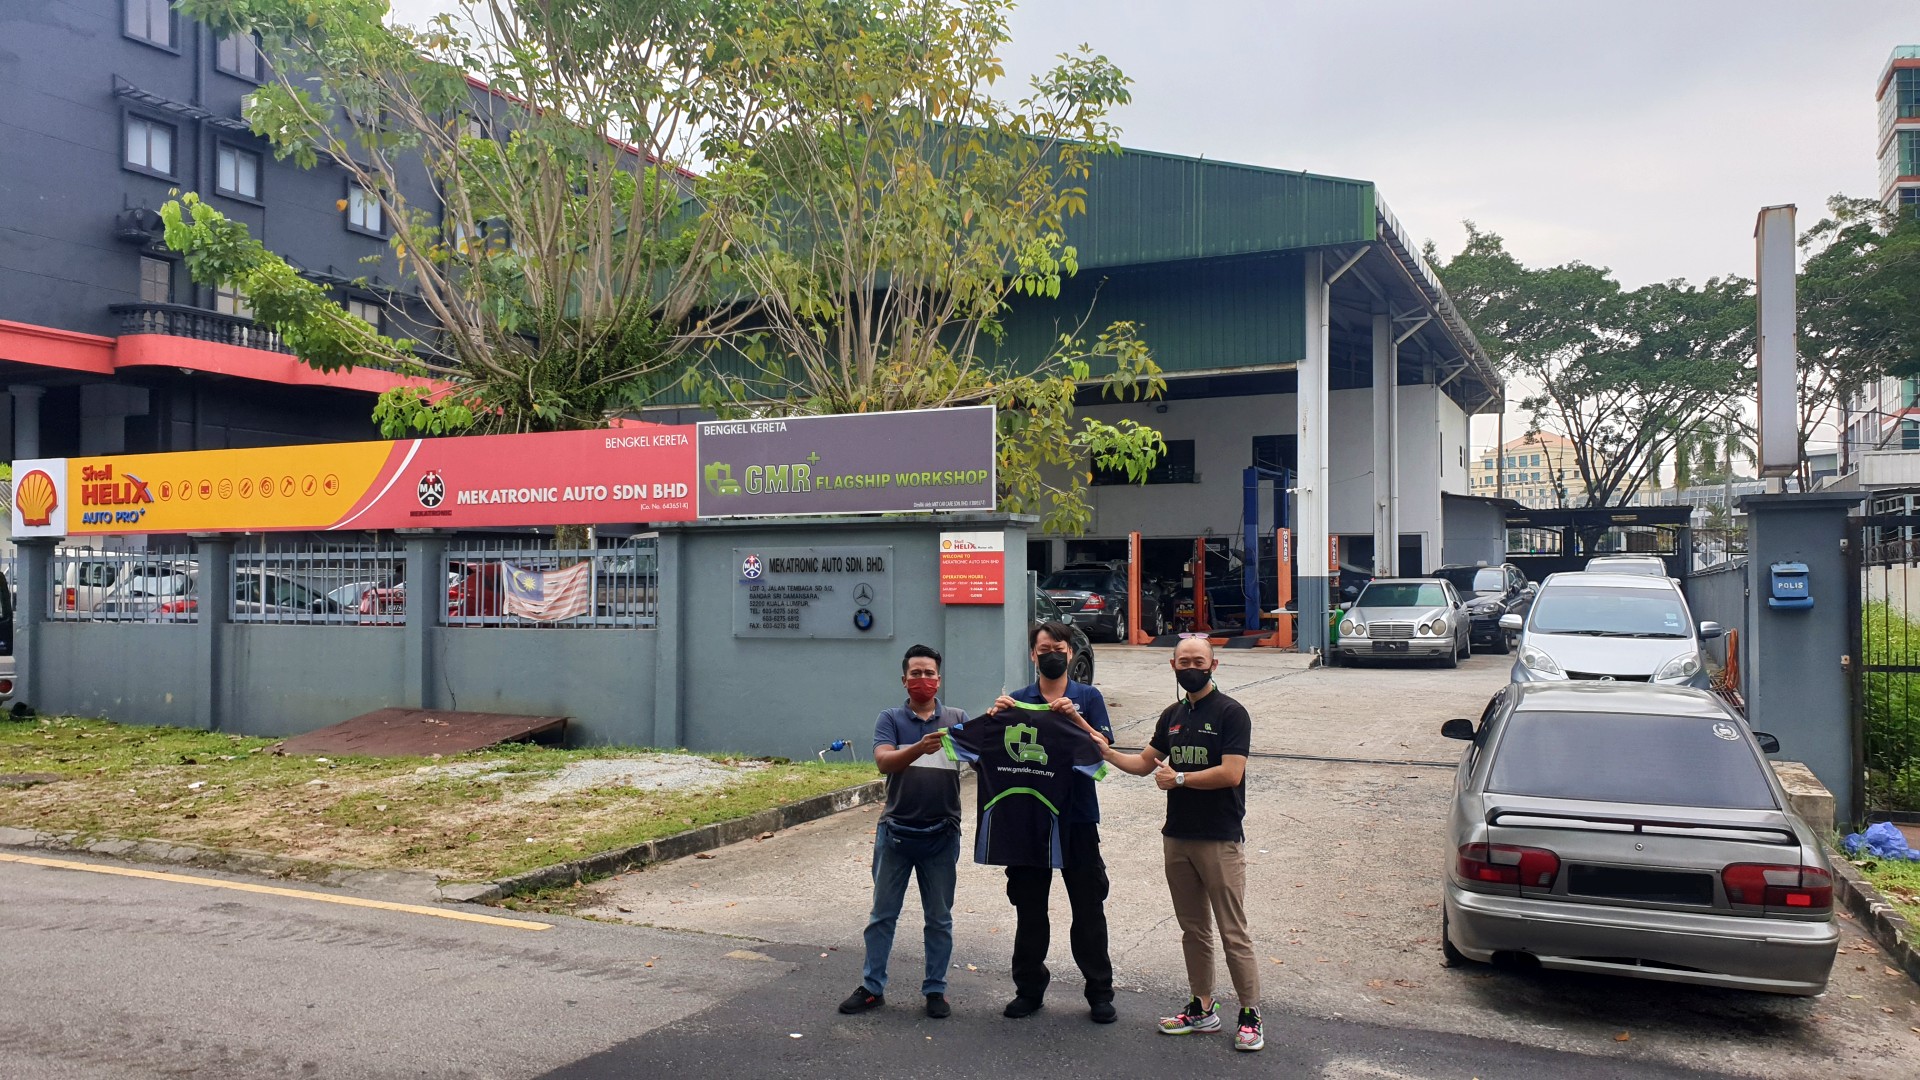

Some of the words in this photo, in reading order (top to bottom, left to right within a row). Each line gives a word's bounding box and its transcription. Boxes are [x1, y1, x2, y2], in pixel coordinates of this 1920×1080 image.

[704, 424, 748, 436] BENGKEL
[750, 422, 787, 434] KERETA
[605, 436, 650, 449] BENGKEL
[653, 434, 689, 446] KERETA
[82, 464, 112, 481] Shell
[816, 473, 891, 490] FLAGSHIP
[895, 469, 988, 487] WORKSHOP
[81, 473, 154, 506] HELIX
[457, 487, 557, 505] MEKATRONIC
[562, 485, 608, 502] AUTO
[612, 484, 647, 501] SDN
[653, 483, 688, 499] BHD
[82, 512, 113, 524] AUTO
[954, 542, 976, 550] HELIX
[769, 558, 818, 573] MEKATRONIC
[821, 557, 843, 572] AUTO
[845, 557, 864, 572] SDN.
[866, 557, 885, 572] BHD.
[1170, 746, 1208, 764] GMR
[997, 766, 1055, 777] www.gmride.com.my
